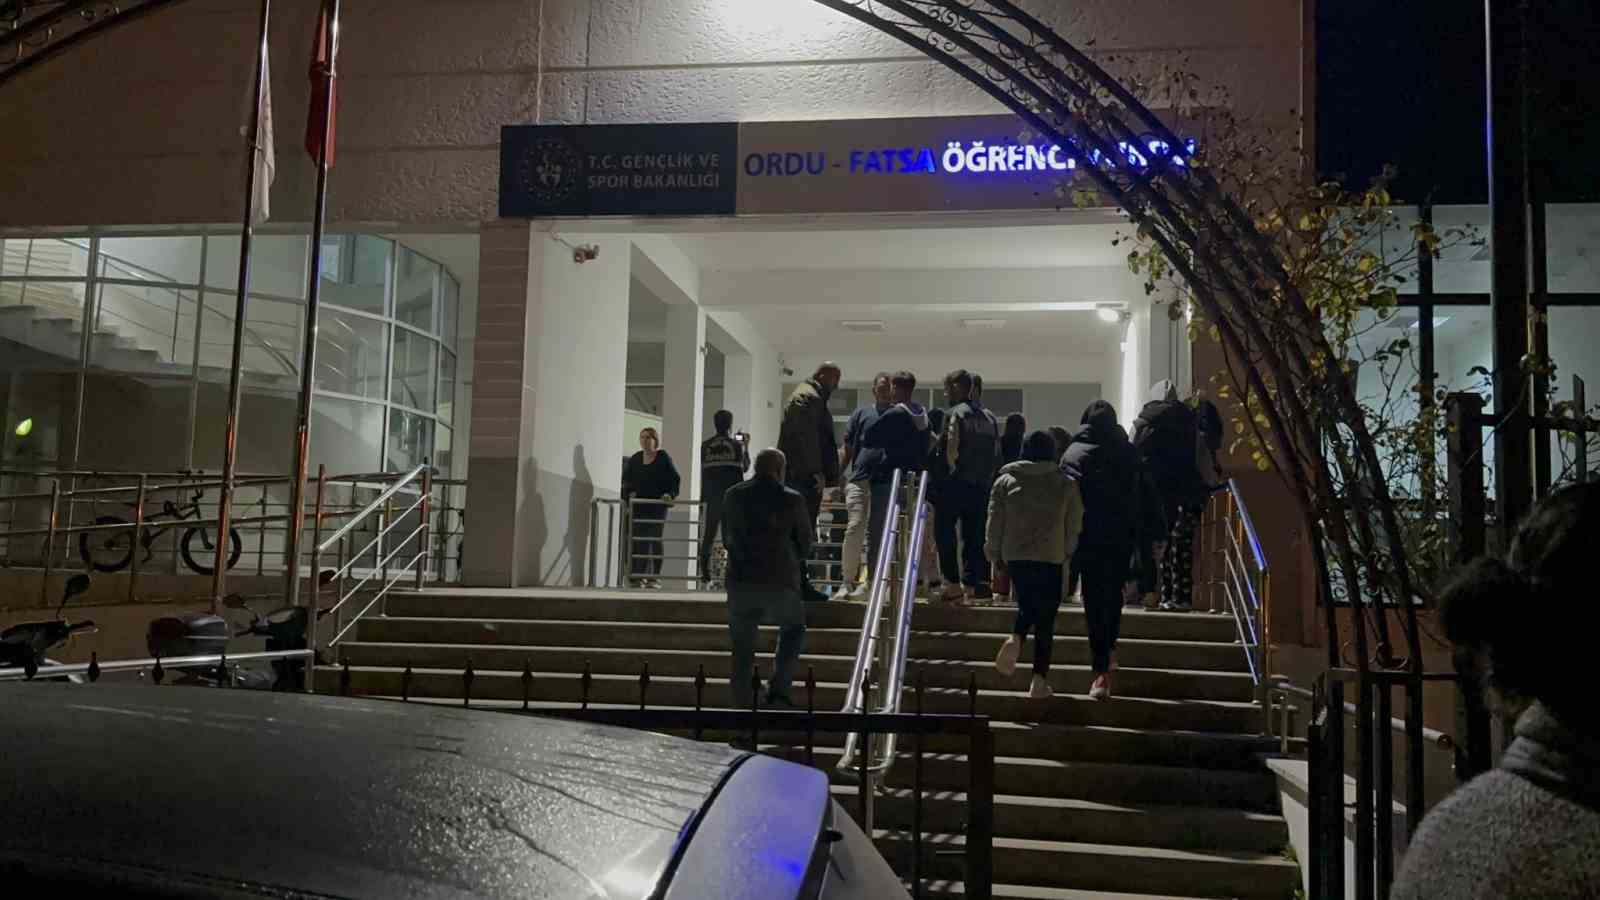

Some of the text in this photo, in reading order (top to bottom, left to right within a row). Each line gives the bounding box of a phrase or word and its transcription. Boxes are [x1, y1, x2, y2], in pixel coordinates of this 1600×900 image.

[588, 152, 720, 171] T.C. GENÇLİK VE
[744, 151, 825, 177] ORDU
[849, 148, 937, 174] FATSA
[587, 173, 630, 189] SPOR
